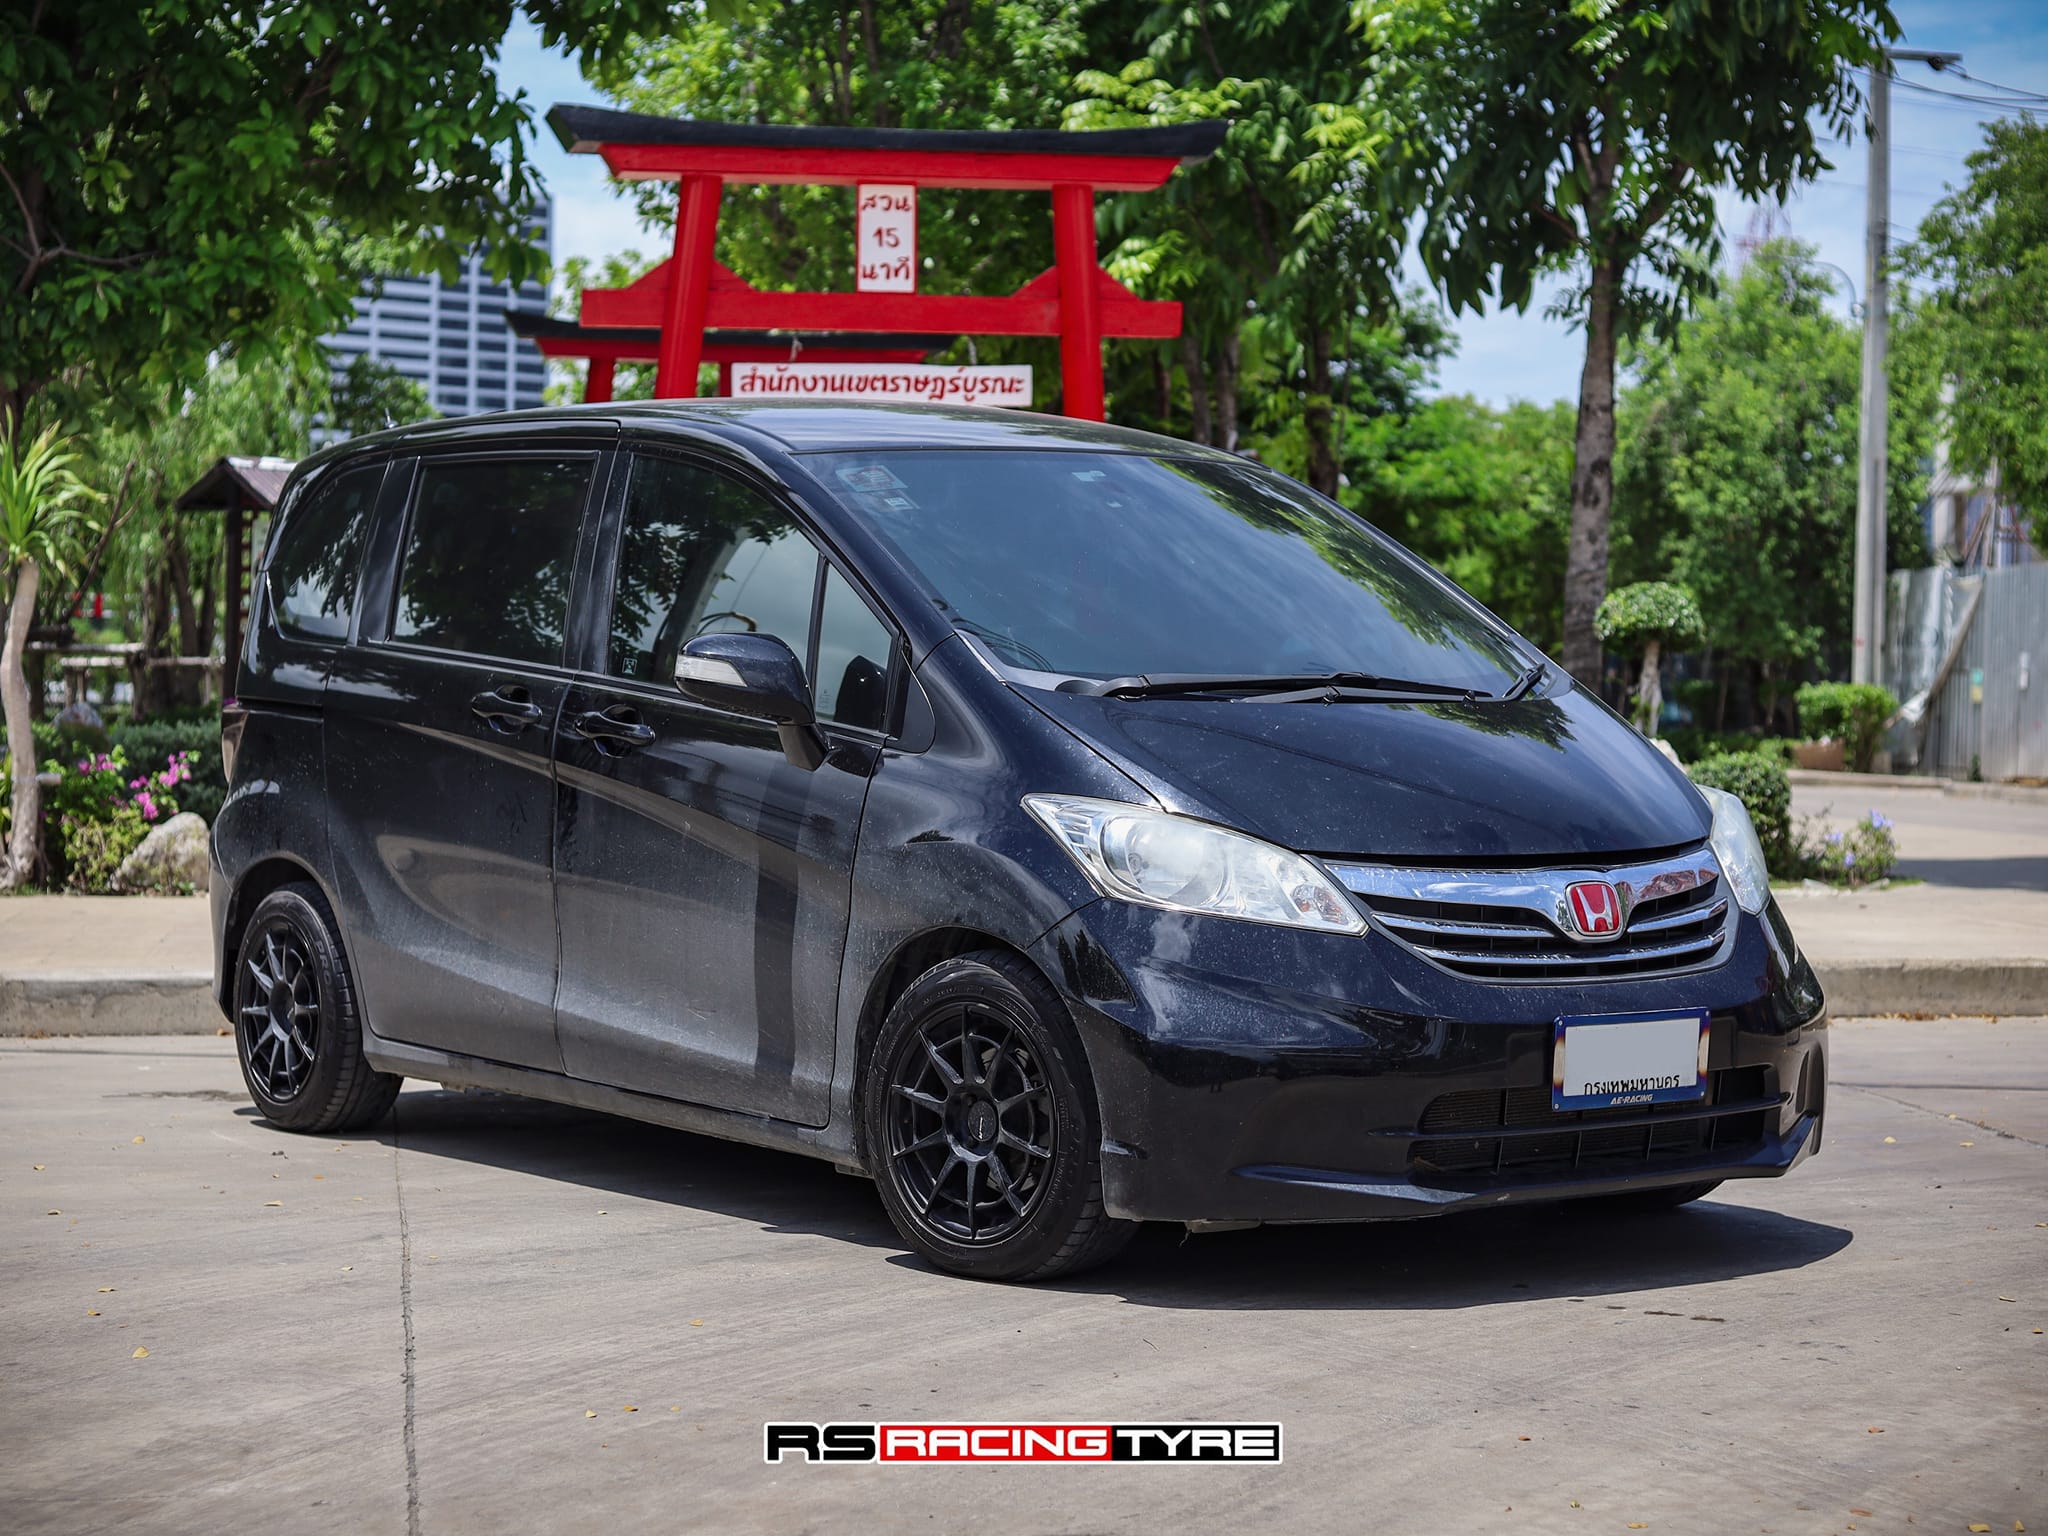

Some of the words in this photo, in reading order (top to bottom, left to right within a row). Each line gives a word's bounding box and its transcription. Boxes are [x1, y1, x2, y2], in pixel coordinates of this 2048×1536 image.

[862, 194, 912, 212] สวน
[872, 226, 900, 248] 15
[862, 256, 910, 280] นาที
[740, 364, 1024, 401] สำนักงานเขตราษฎร์บูรณะ
[1584, 1074, 1680, 1096] กรงเทพมหานคร
